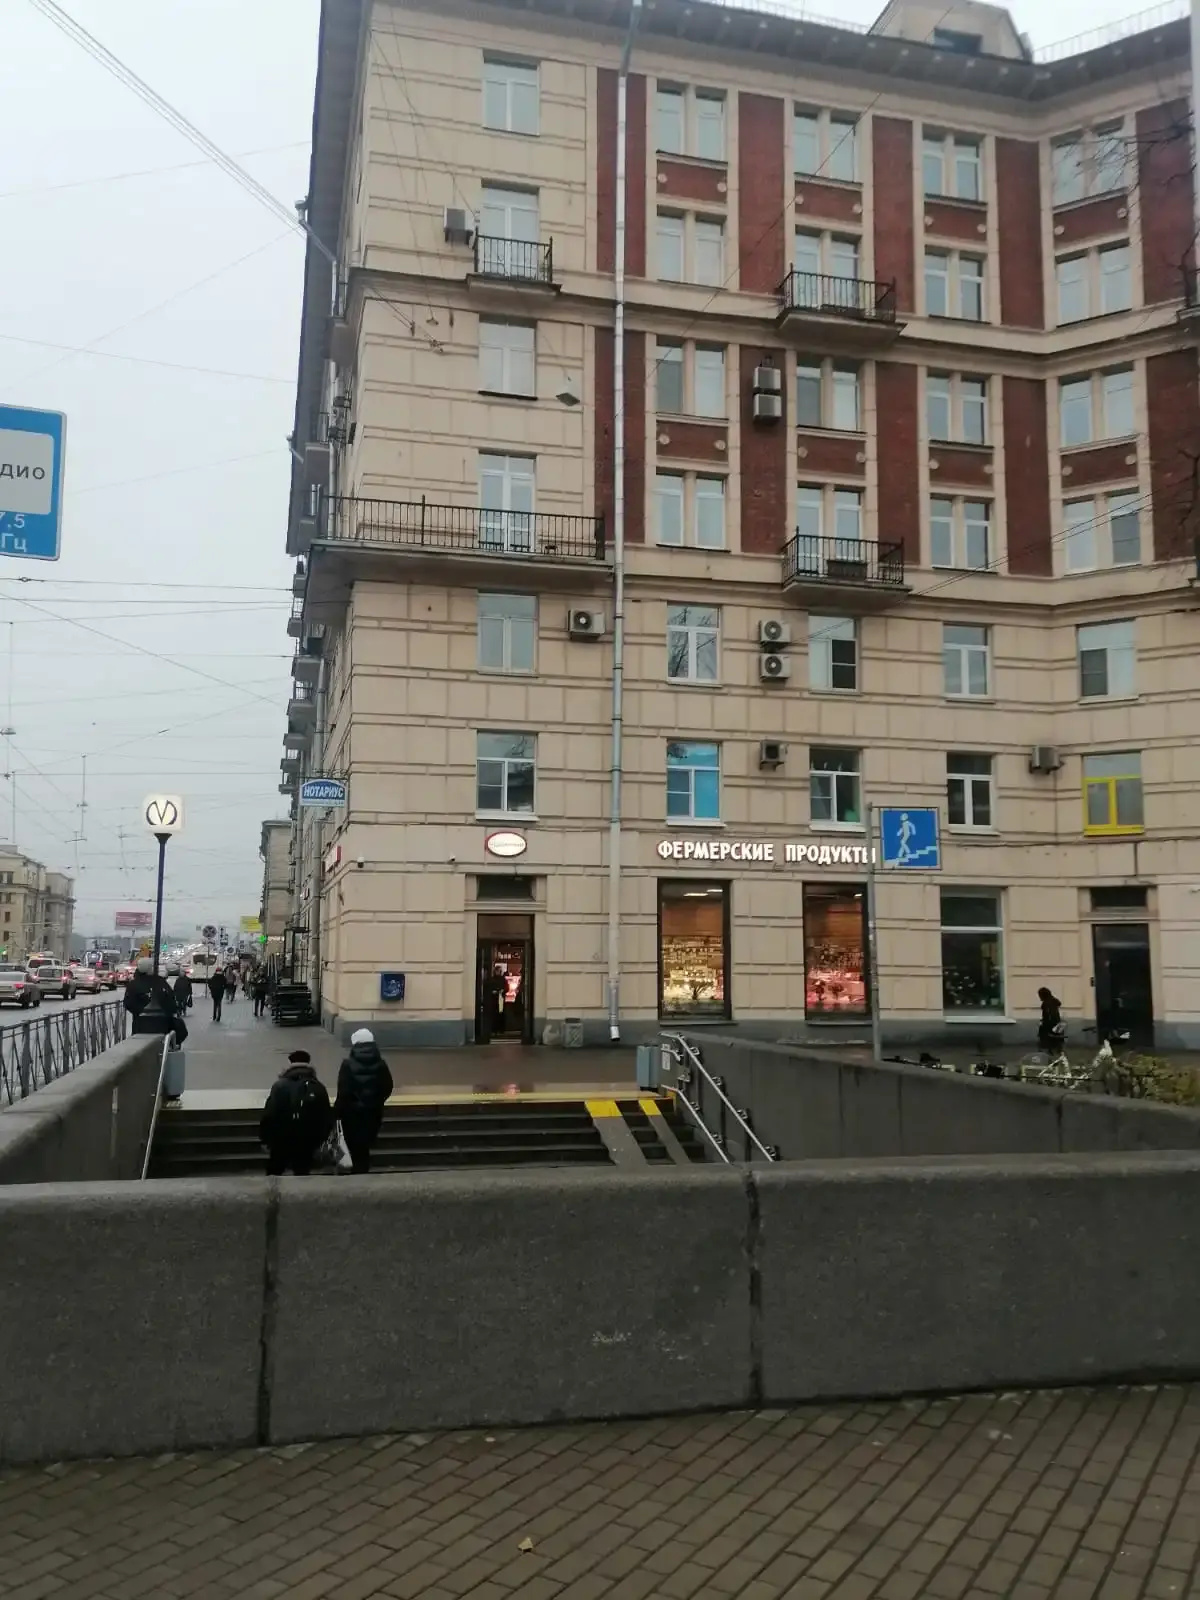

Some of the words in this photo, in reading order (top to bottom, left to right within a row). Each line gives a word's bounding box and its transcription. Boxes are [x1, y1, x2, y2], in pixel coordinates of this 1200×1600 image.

[303, 785, 344, 798] НОТАРИУС
[657, 840, 774, 861] ФЕРМЕРСКИЕ
[784, 844, 876, 865] ПРОДУКТЫ
